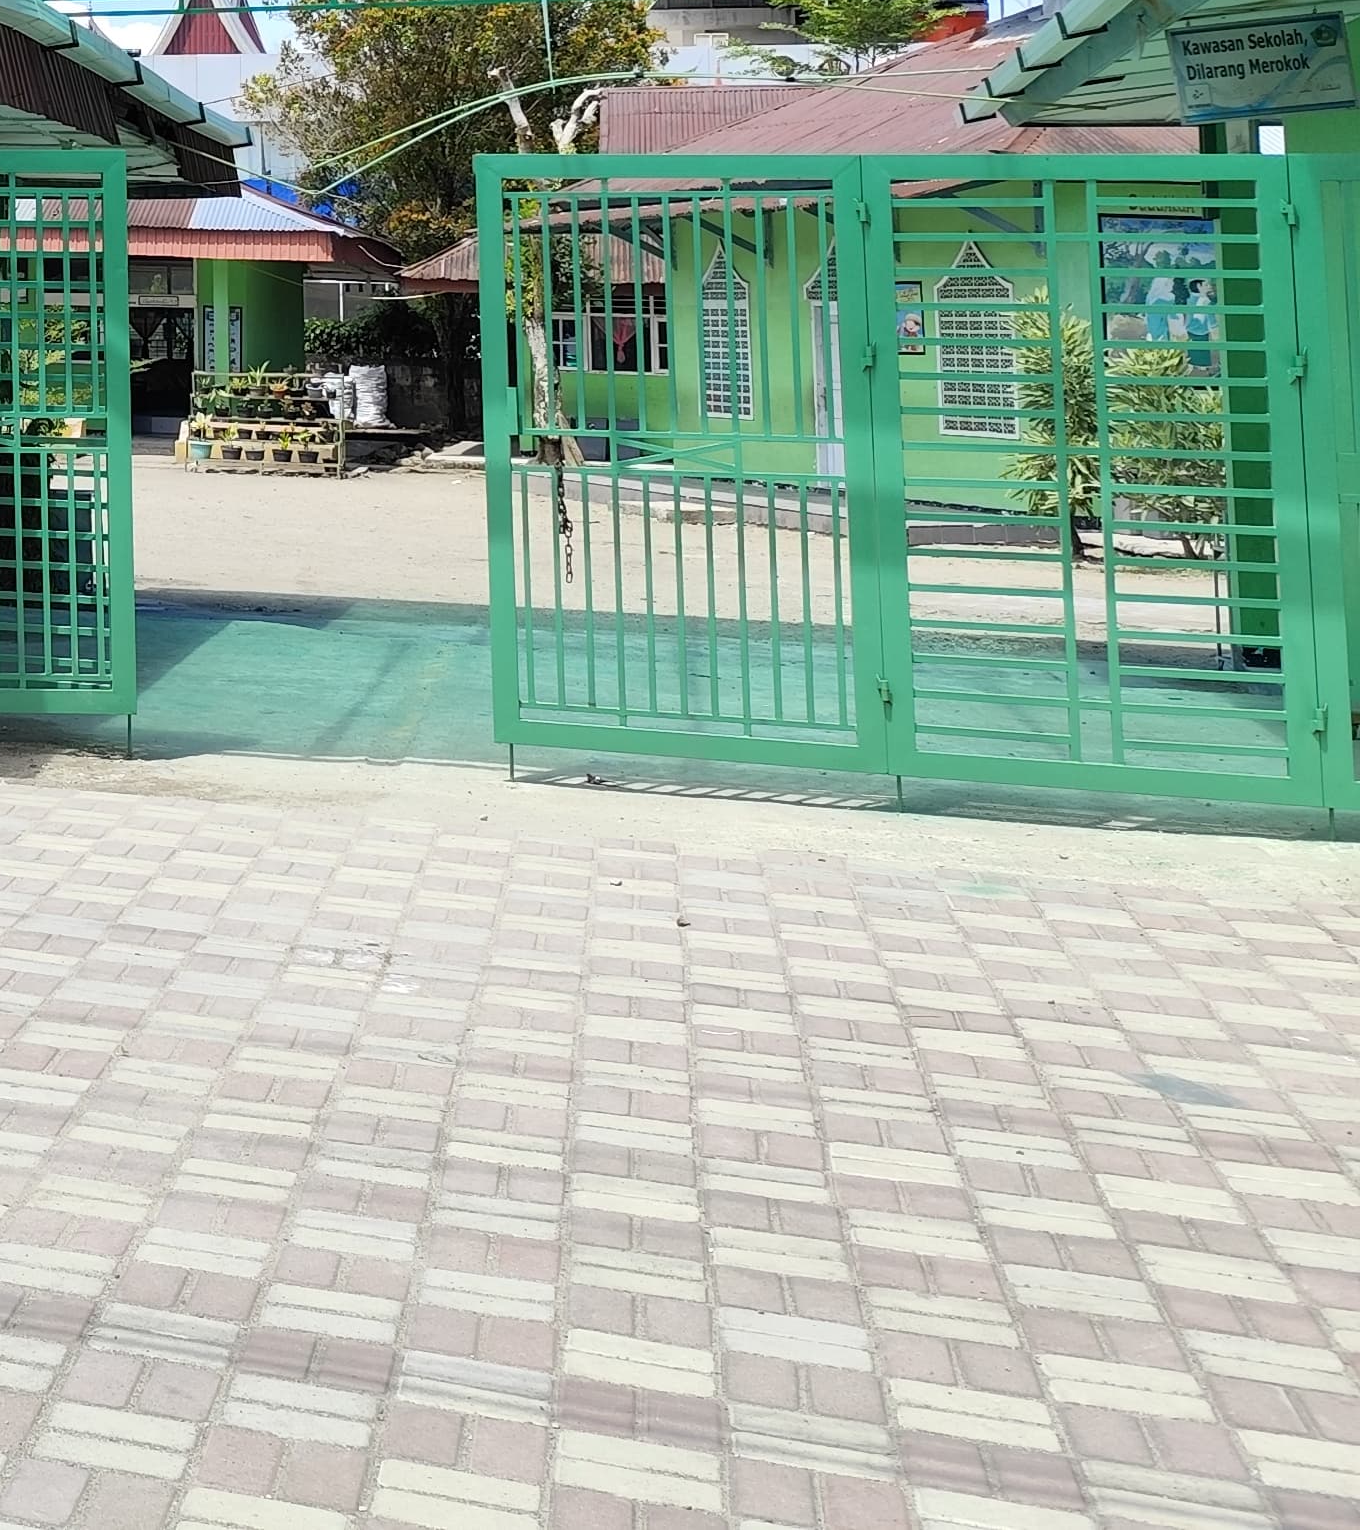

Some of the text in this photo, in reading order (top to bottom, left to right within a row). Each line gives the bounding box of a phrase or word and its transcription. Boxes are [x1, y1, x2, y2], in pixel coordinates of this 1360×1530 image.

[1182, 28, 1308, 56] Kawasan Sekolah,
[1185, 53, 1311, 81] Dilarang Merokok
